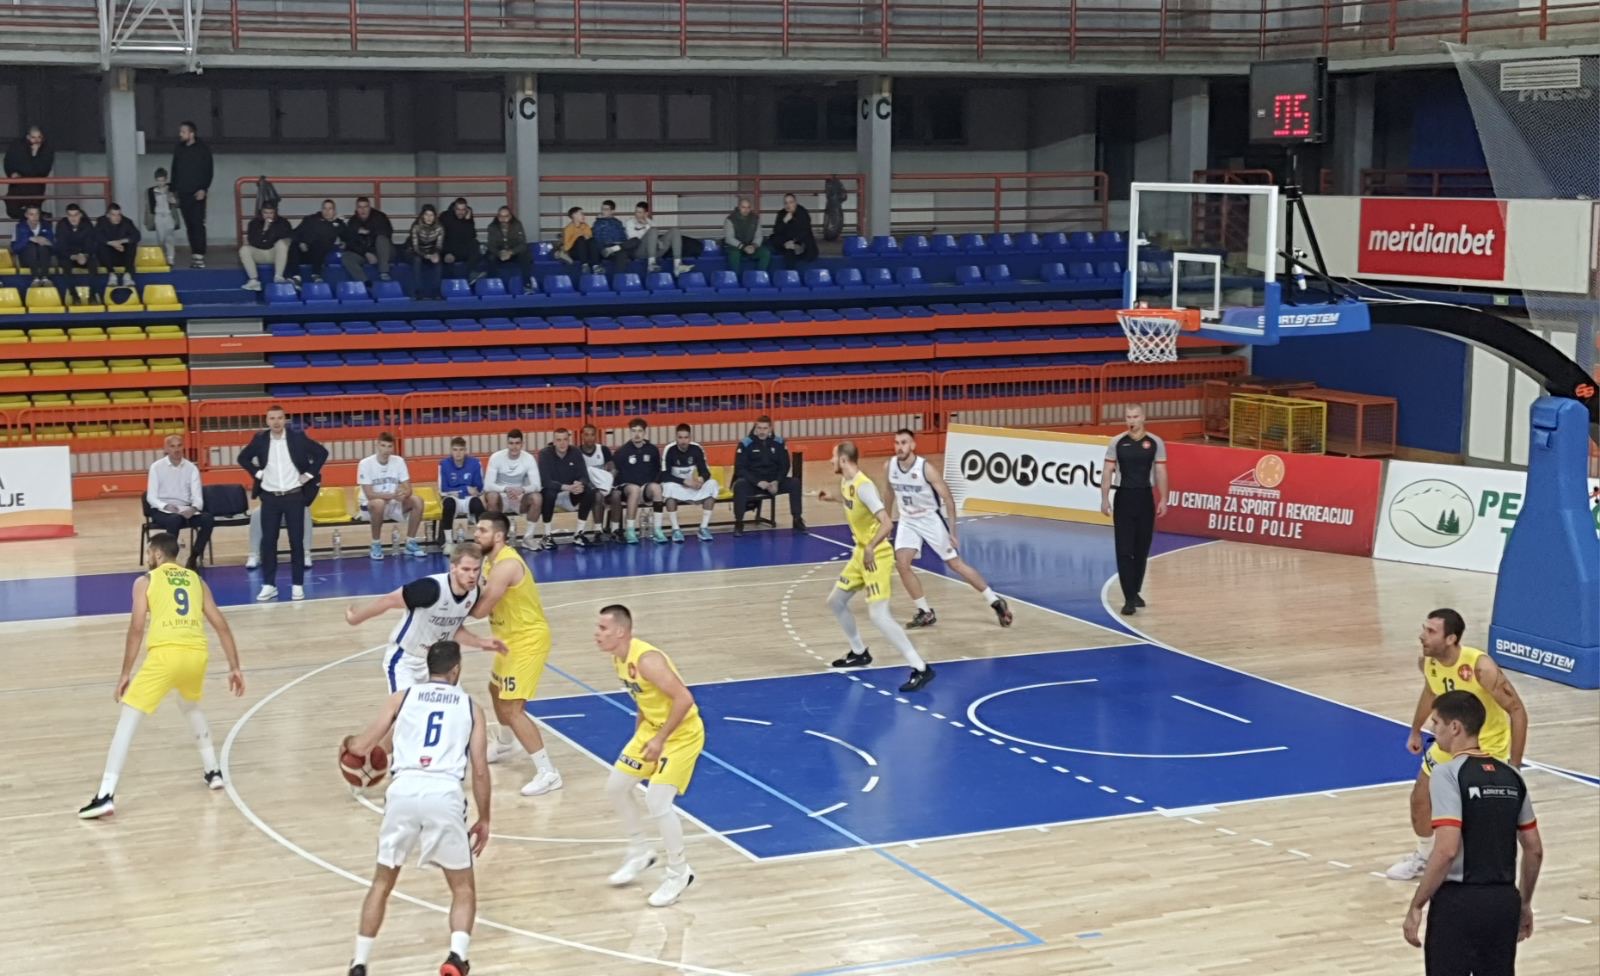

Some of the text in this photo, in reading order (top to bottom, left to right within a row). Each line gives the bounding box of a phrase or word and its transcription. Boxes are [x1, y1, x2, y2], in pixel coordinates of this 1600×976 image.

[519, 96, 537, 121] C
[875, 97, 891, 121] C
[1367, 223, 1496, 256] meridianbet
[1257, 312, 1340, 328] SRTSYSTEM
[1166, 490, 1354, 526] JU CENTAR ZA SPORT I REKREACIJU
[1208, 512, 1304, 539] BIJELO POLJE
[173, 587, 190, 617] 9
[1495, 638, 1576, 670] SPORTSYSTEM
[503, 676, 516, 692] 15
[423, 710, 445, 748] 6
[658, 756, 669, 774] 7
